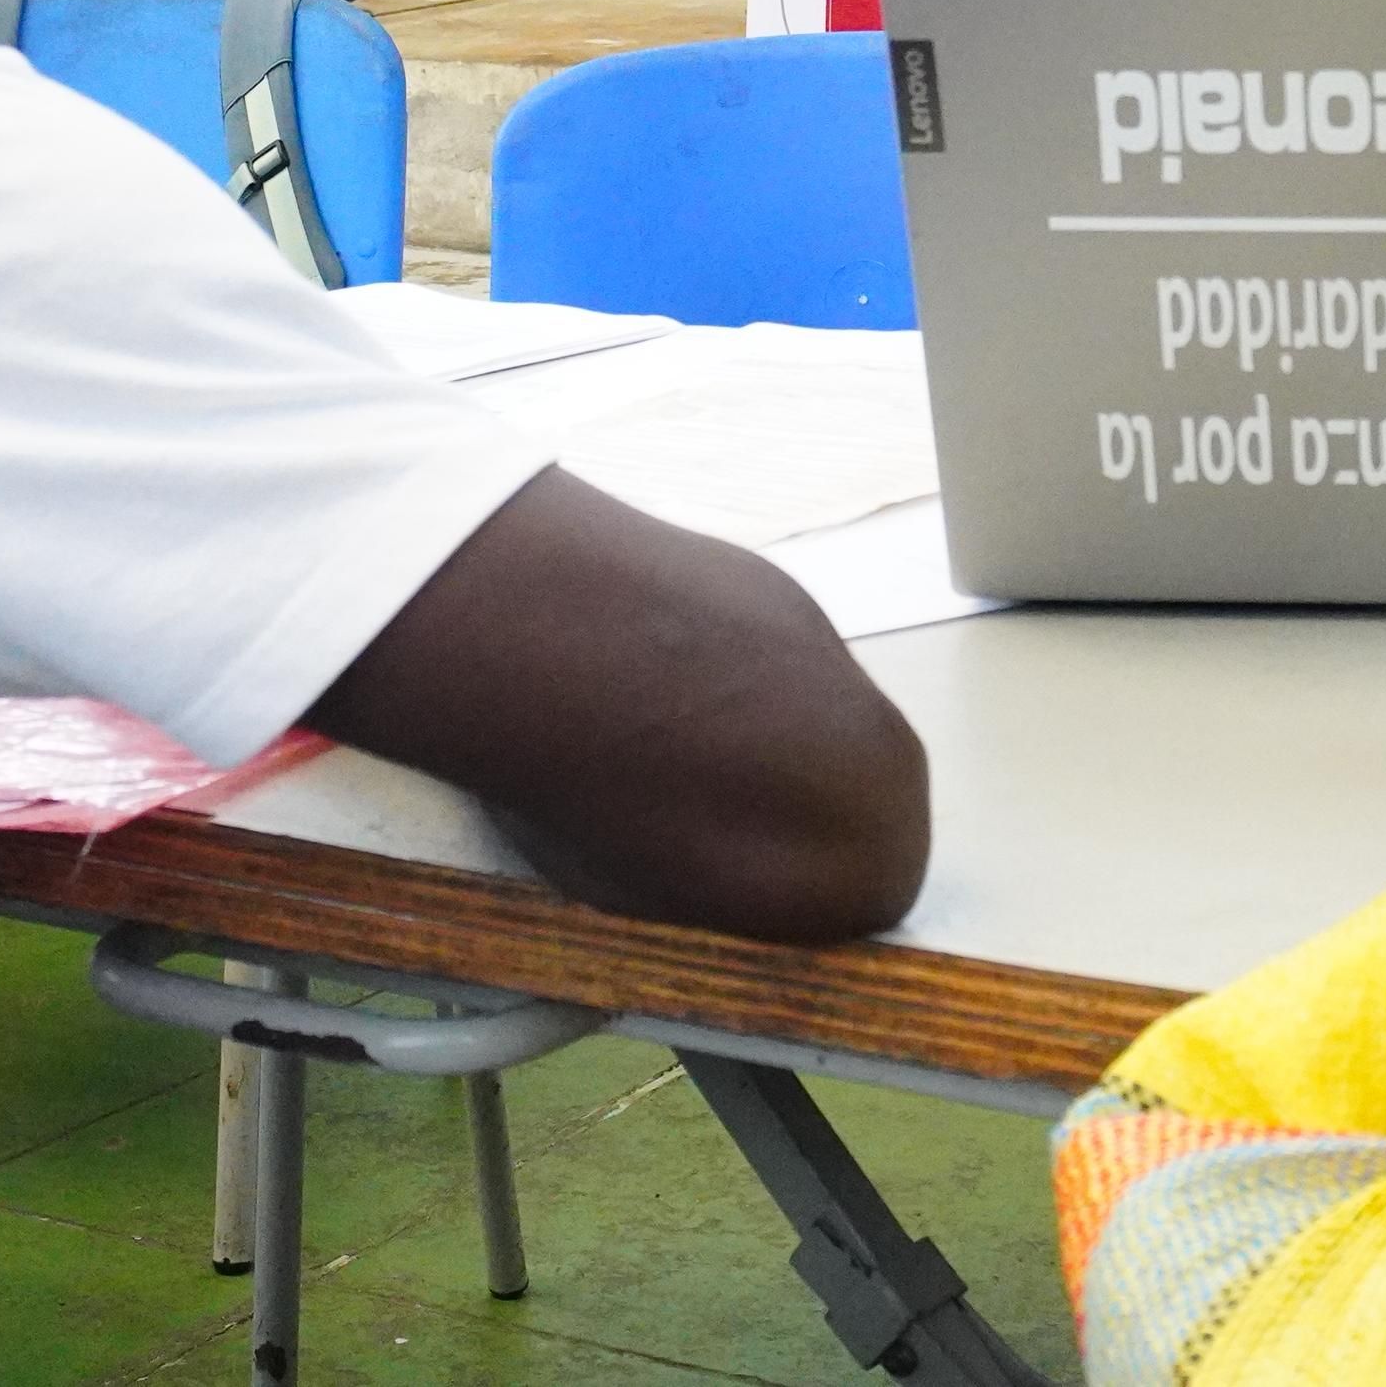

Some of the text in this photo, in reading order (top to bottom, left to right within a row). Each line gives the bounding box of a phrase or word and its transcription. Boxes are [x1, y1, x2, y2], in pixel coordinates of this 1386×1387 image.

[903, 50, 933, 144] Lenovo
[1098, 412, 1158, 503] la
[1173, 393, 1274, 485] por
